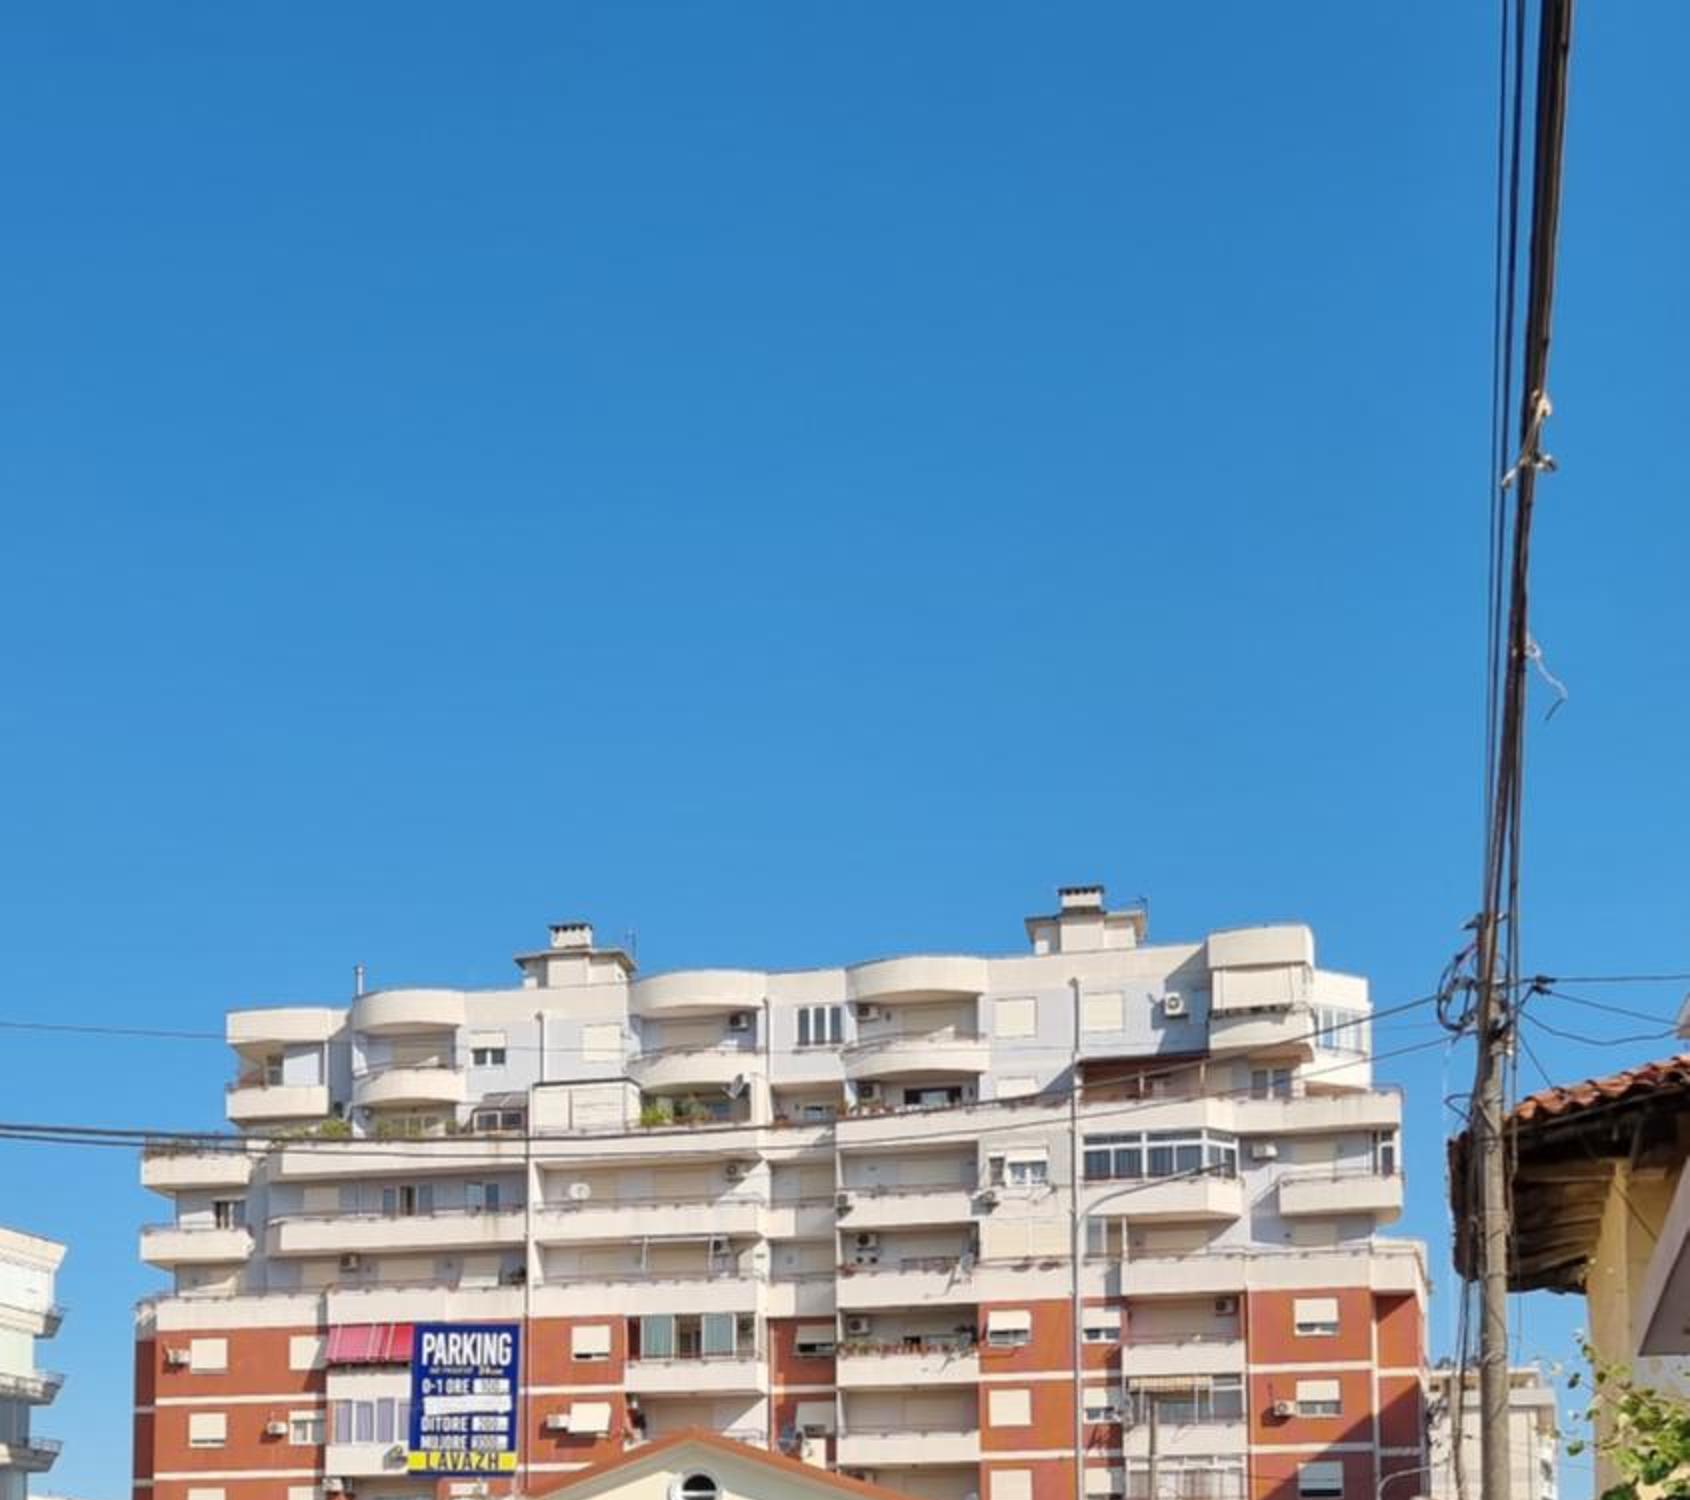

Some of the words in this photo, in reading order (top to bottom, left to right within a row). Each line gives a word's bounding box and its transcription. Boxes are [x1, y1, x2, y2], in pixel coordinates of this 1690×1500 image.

[421, 1333, 511, 1366] PARKING
[421, 1378, 443, 1394] 0-1
[425, 1452, 499, 1470] LAVAZH
